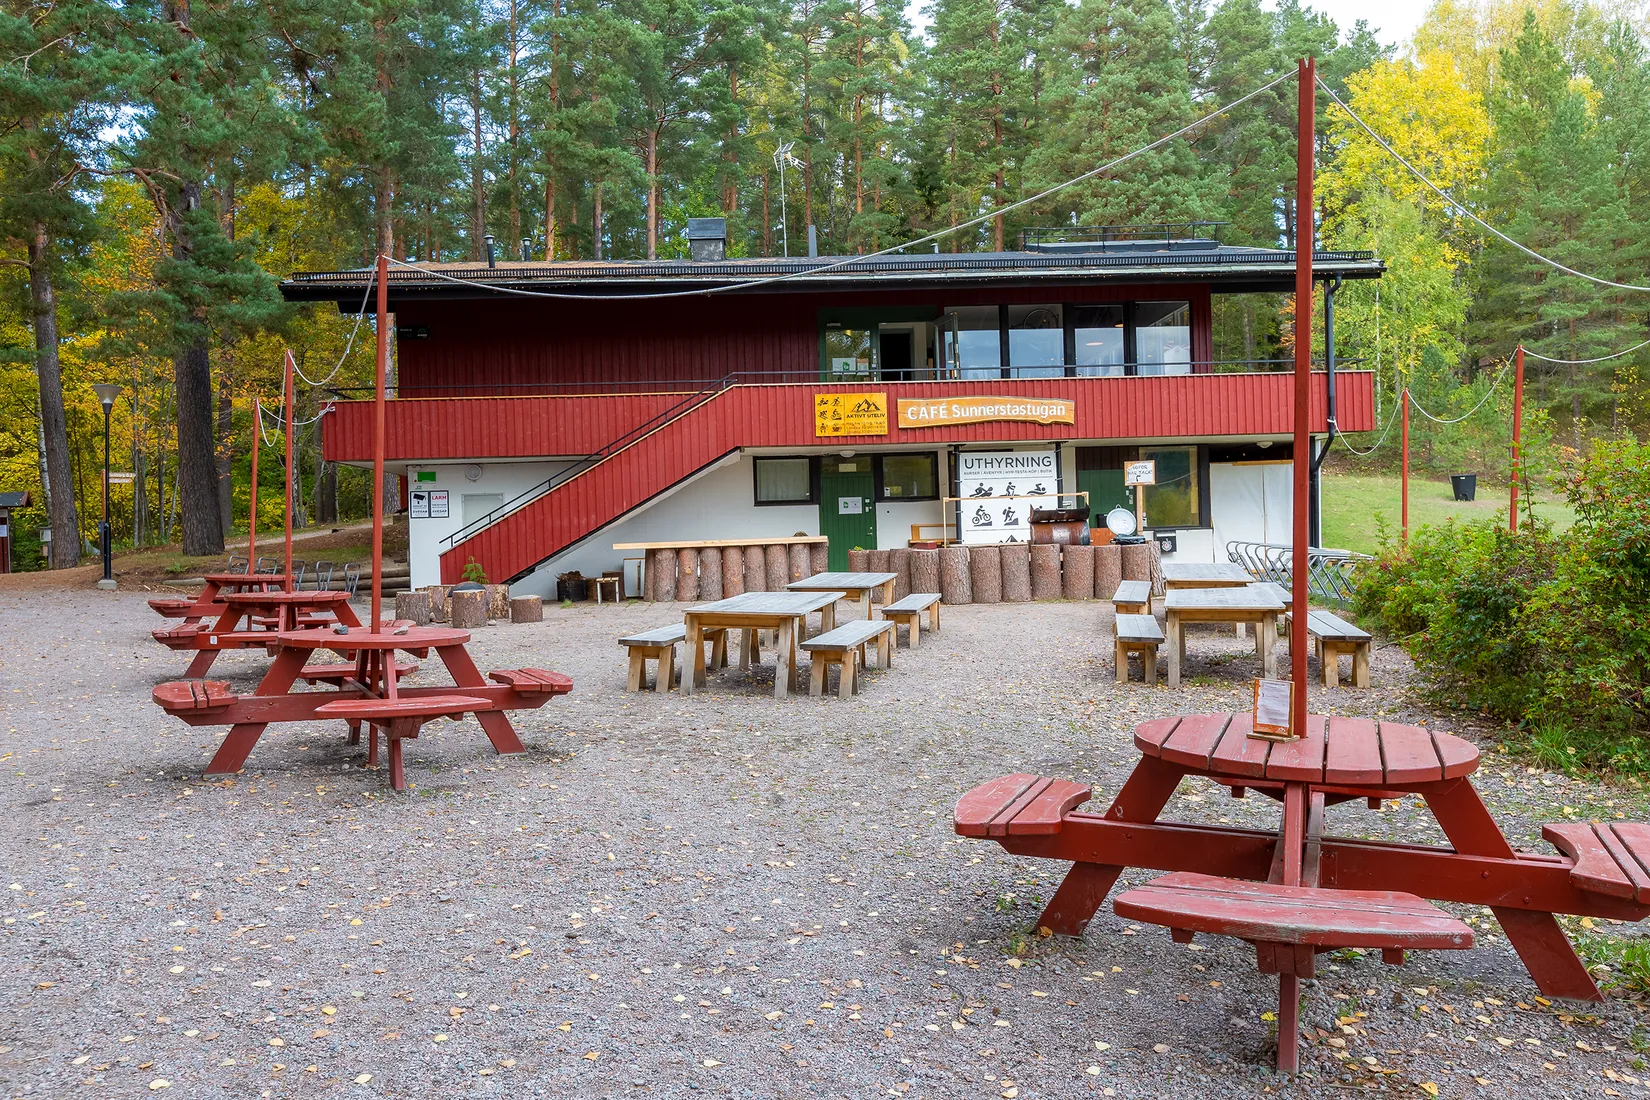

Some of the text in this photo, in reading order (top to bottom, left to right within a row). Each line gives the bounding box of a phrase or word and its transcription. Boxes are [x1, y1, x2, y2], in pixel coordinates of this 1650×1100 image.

[907, 402, 1066, 420] CAFÉ Sunnerstastugan
[964, 456, 1052, 469] UTHYRNING
